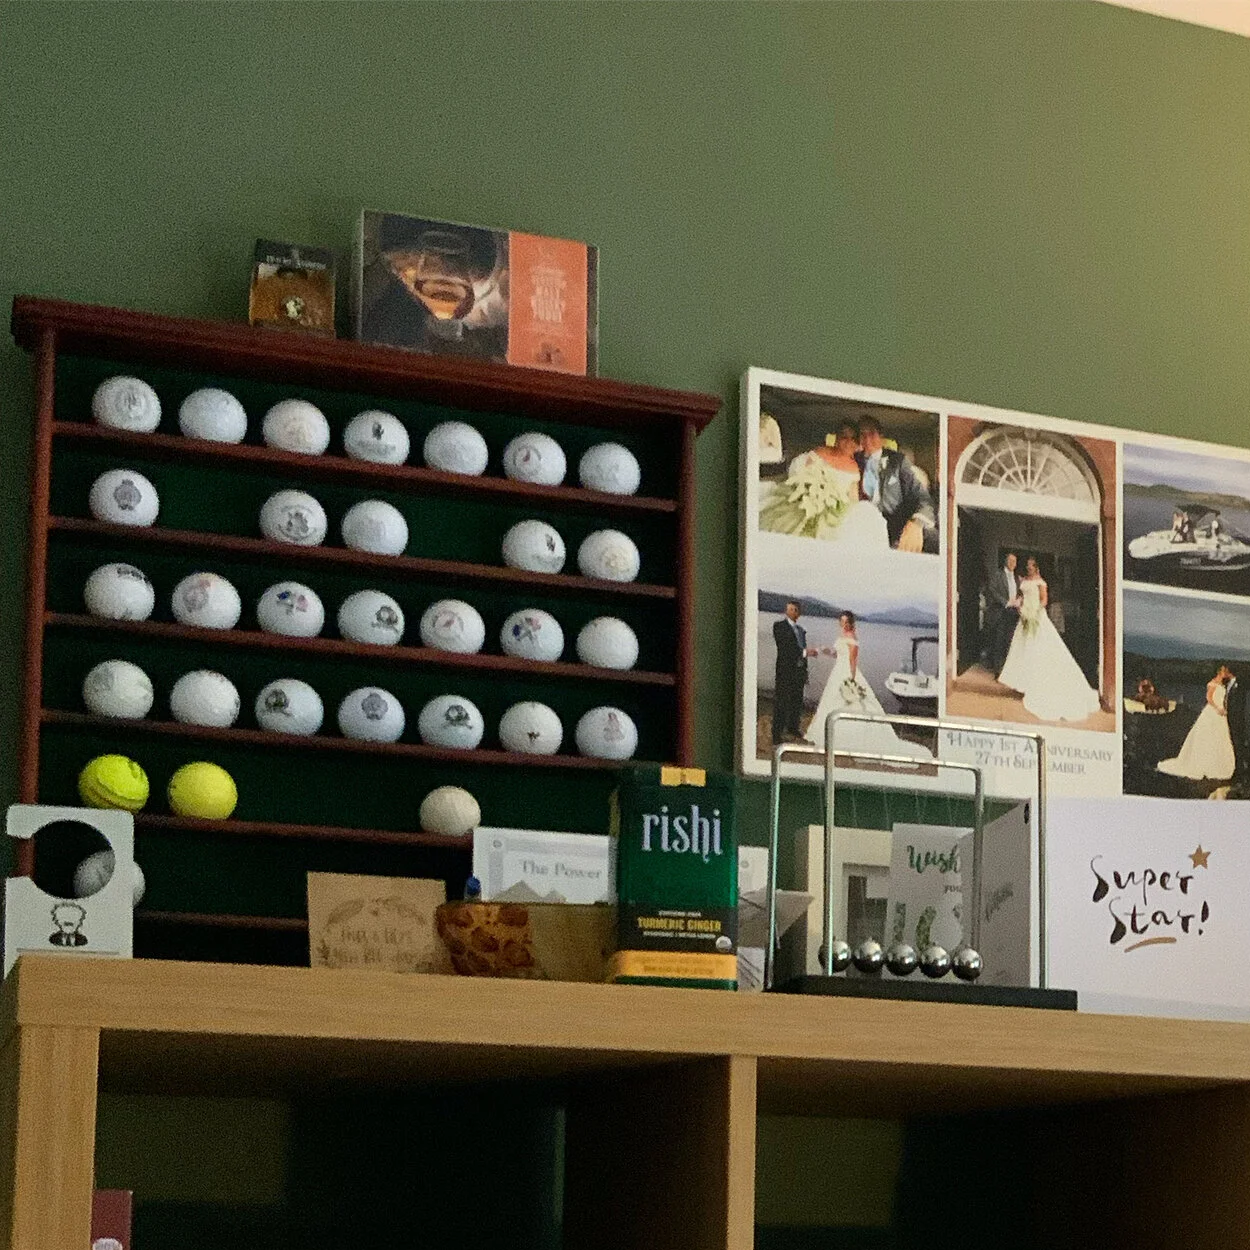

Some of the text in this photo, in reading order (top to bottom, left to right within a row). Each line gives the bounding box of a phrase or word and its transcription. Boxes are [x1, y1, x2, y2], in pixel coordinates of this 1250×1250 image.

[641, 804, 724, 864] rishi
[519, 860, 602, 878] The Power
[1090, 855, 1194, 906] Super
[1109, 896, 1209, 944] Star!
